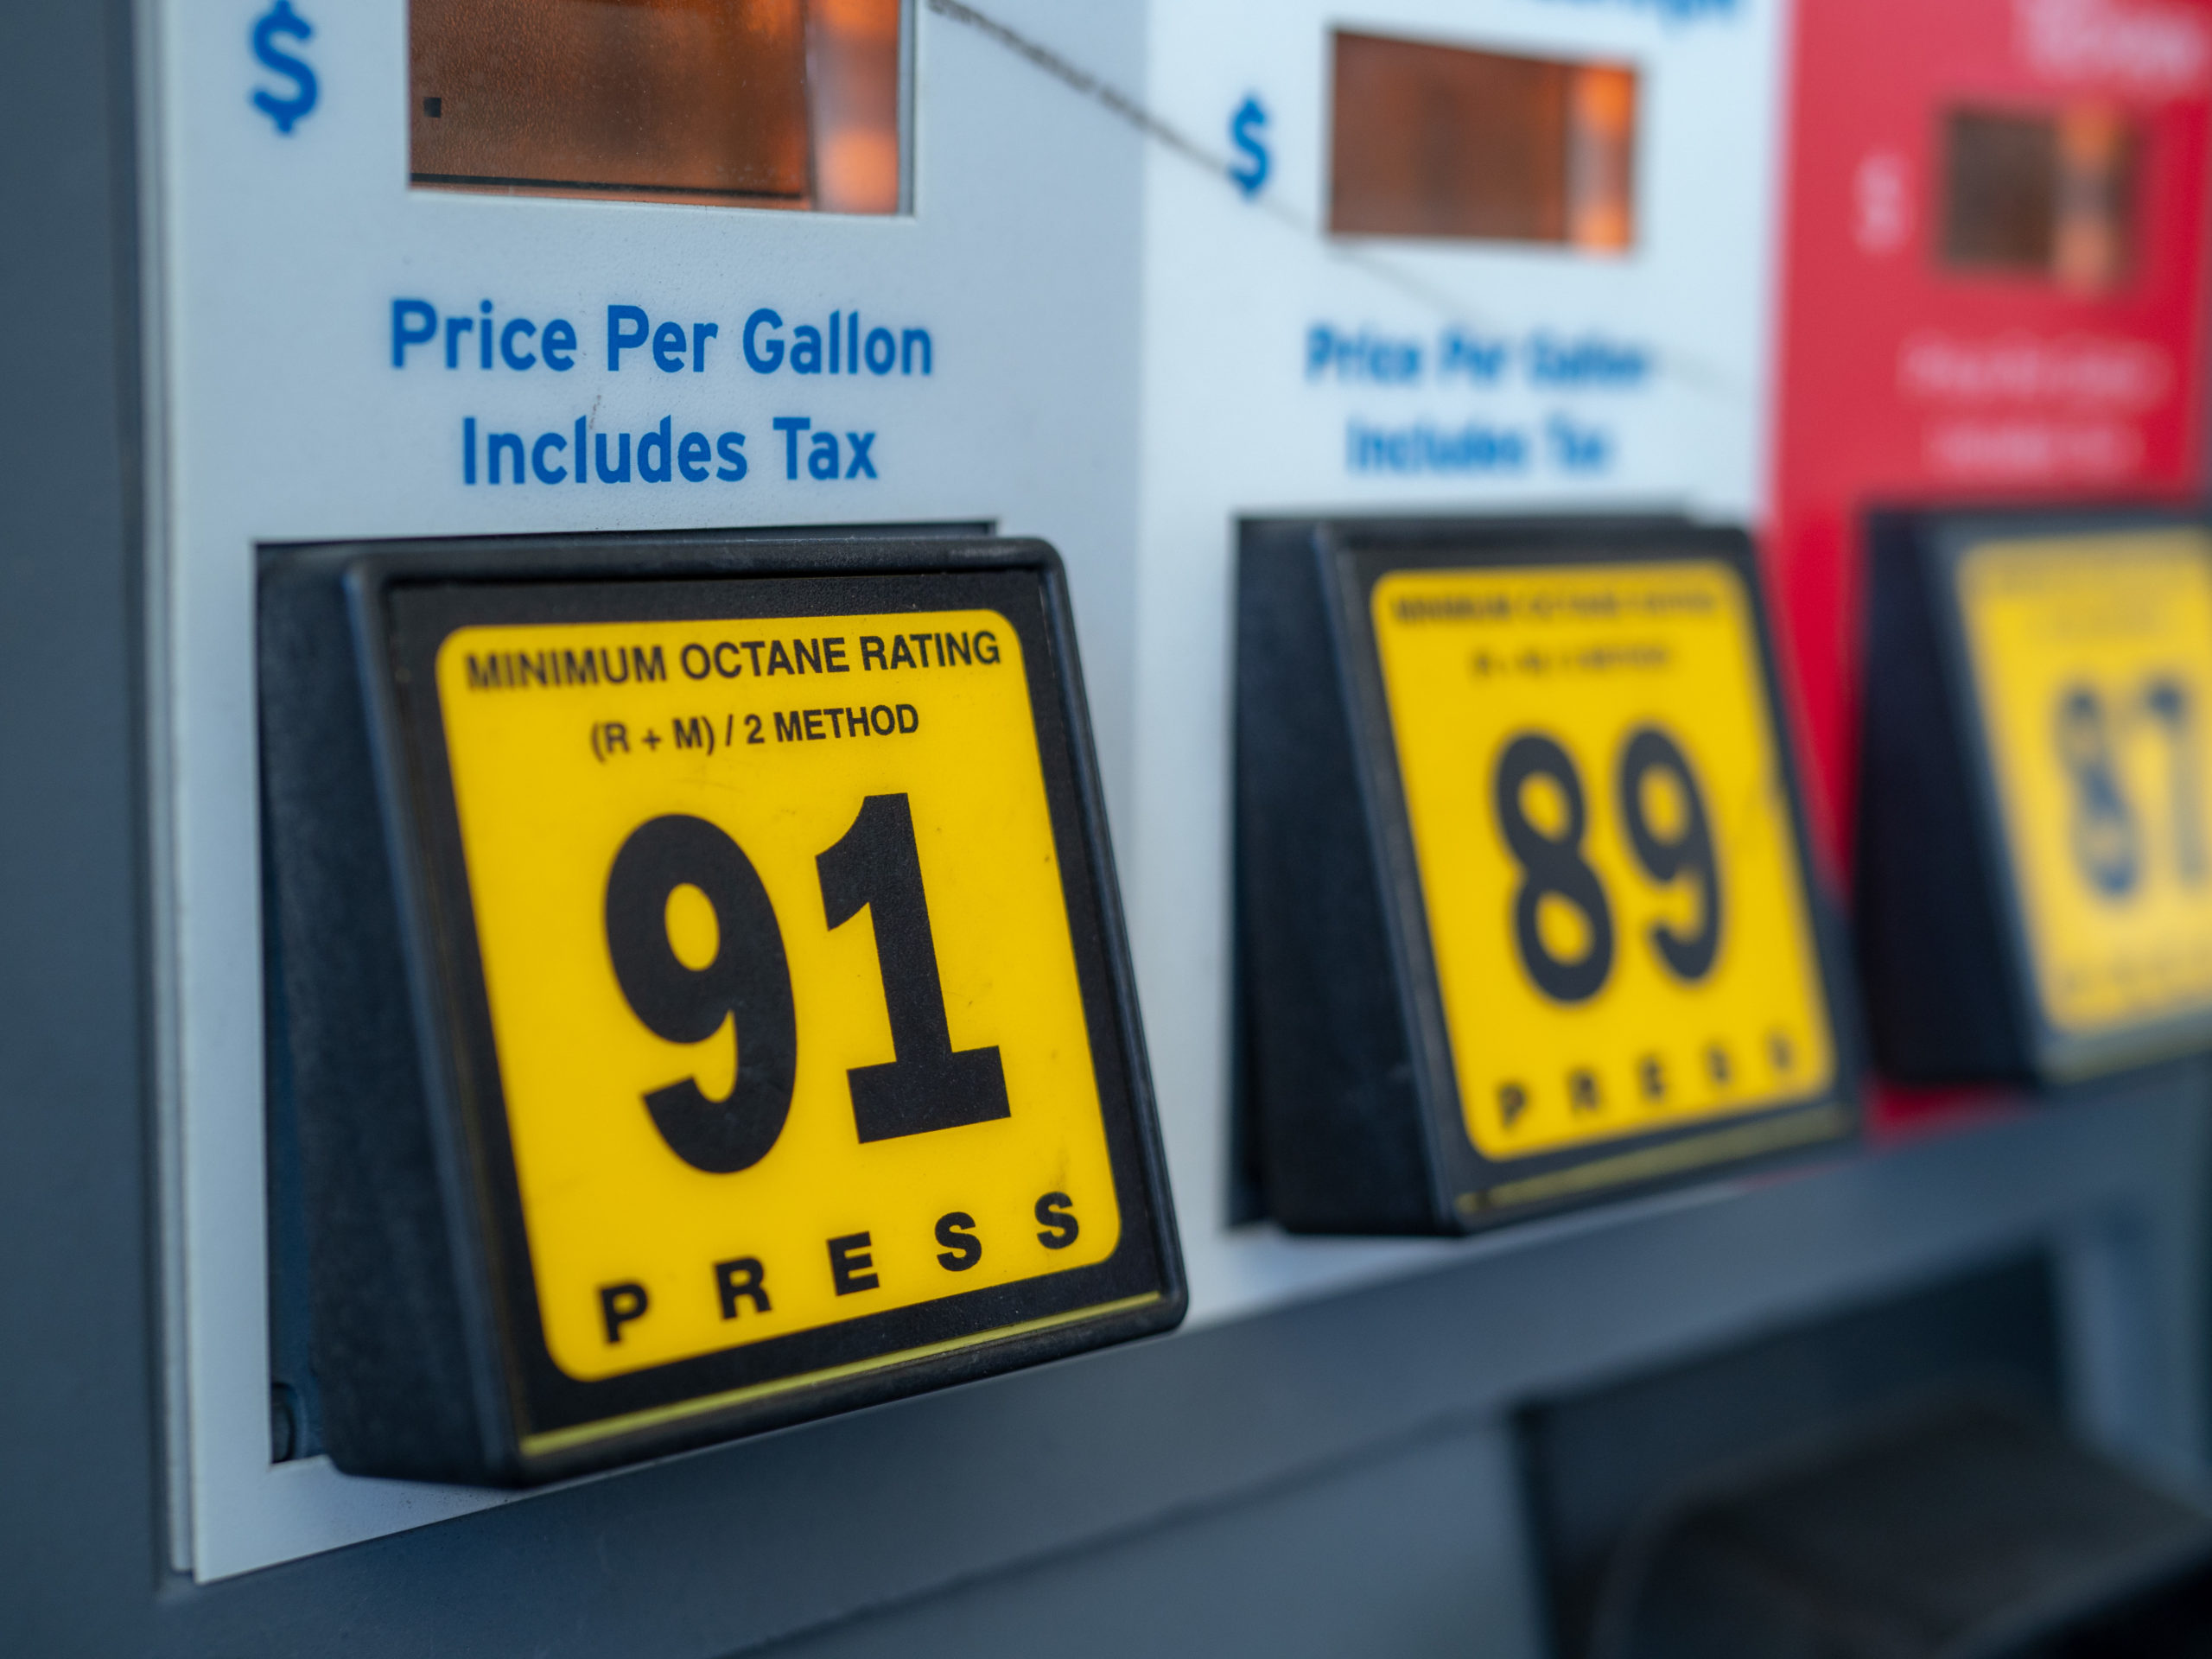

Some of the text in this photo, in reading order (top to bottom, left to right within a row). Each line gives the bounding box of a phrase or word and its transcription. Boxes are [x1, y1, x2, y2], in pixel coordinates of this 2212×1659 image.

[250, 0, 320, 136] $
[1227, 93, 1273, 200] $
[391, 298, 933, 376] Price Per Gallon
[462, 414, 879, 486] Includes Tax
[466, 630, 1001, 690] MINIMUM OCTANE RATING
[591, 703, 919, 762] (R + M) / 2 METHOD
[2050, 670, 2212, 910] 87
[1491, 724, 1726, 1007] 89
[603, 792, 1012, 1175] 91
[598, 1191, 1079, 1344] PRESS
